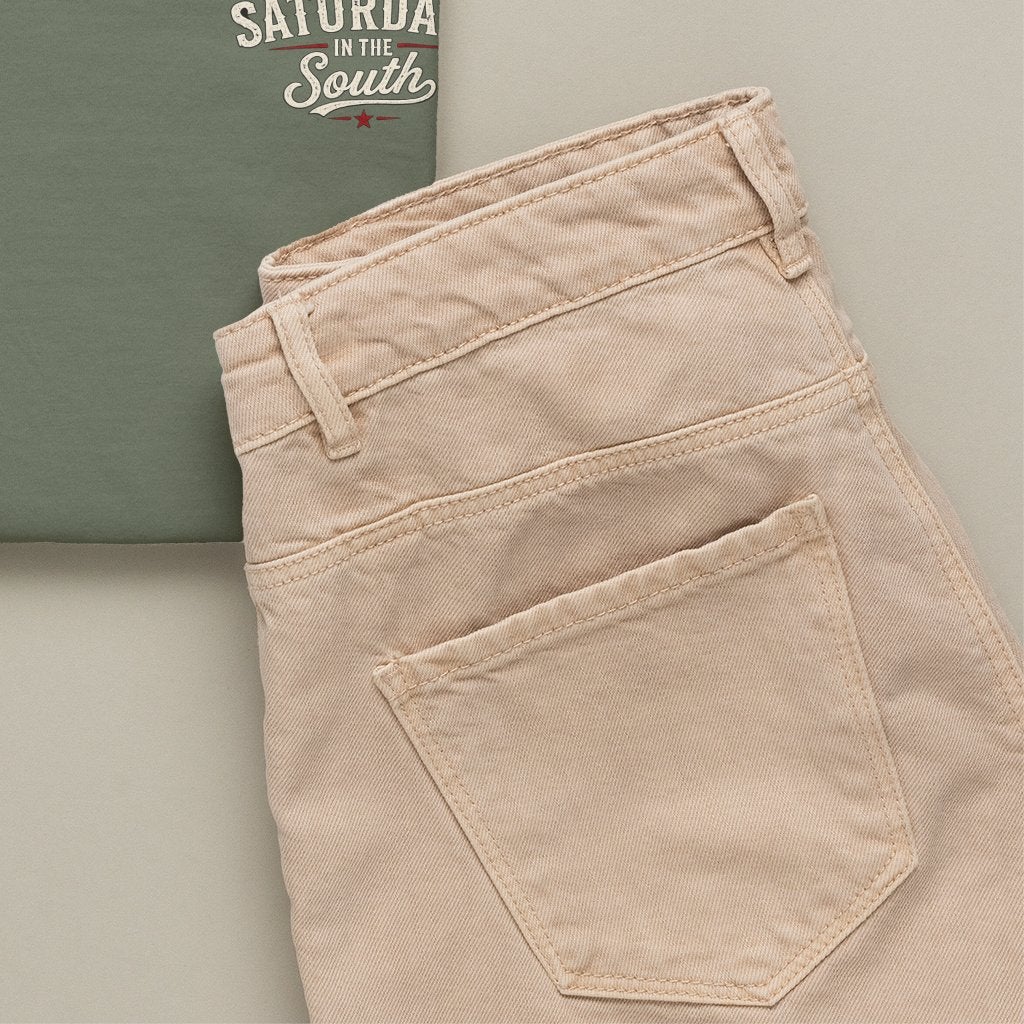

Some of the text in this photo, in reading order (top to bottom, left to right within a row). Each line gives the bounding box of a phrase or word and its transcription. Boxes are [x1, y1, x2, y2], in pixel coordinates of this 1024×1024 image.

[333, 38, 393, 57] IN THE
[283, 51, 437, 117] South
